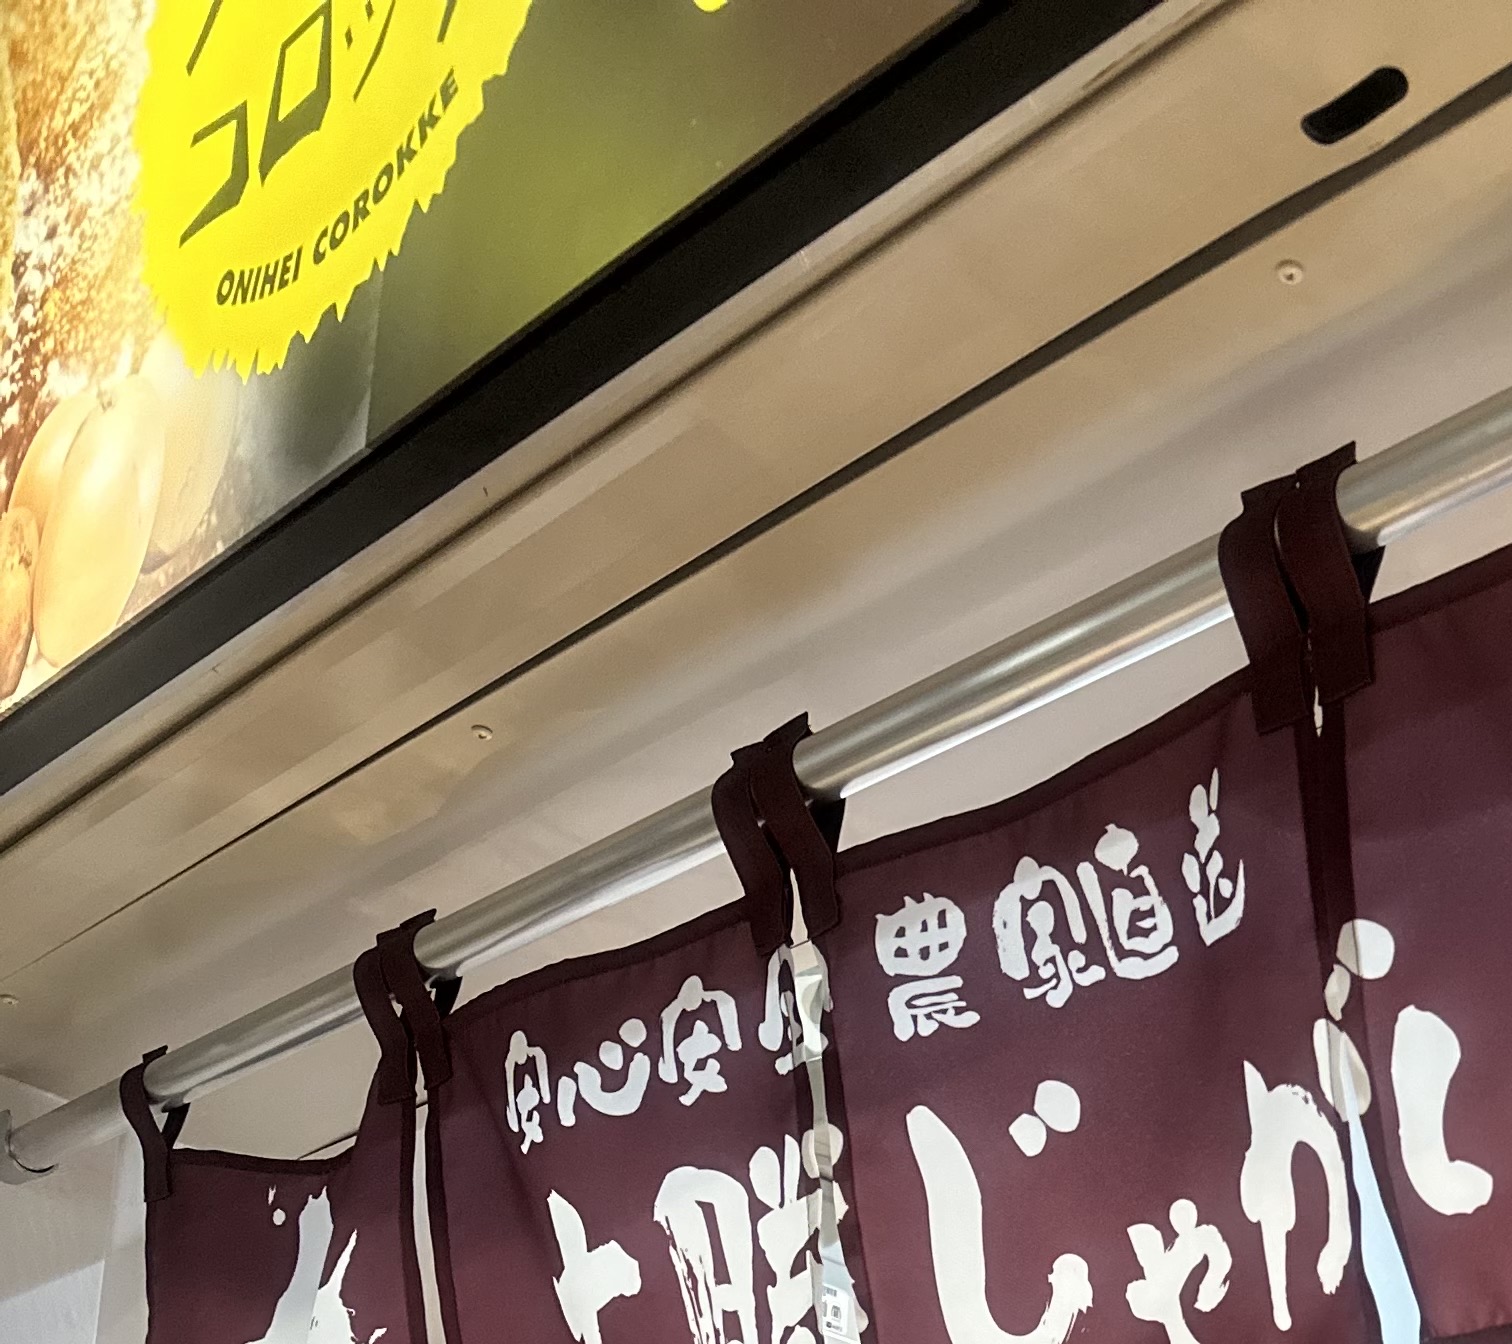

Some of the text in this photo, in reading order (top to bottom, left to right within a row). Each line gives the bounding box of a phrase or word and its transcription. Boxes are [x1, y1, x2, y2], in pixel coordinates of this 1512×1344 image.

[178, 0, 457, 248] コロッ
[216, 67, 461, 307] ONIHEI COROKKE
